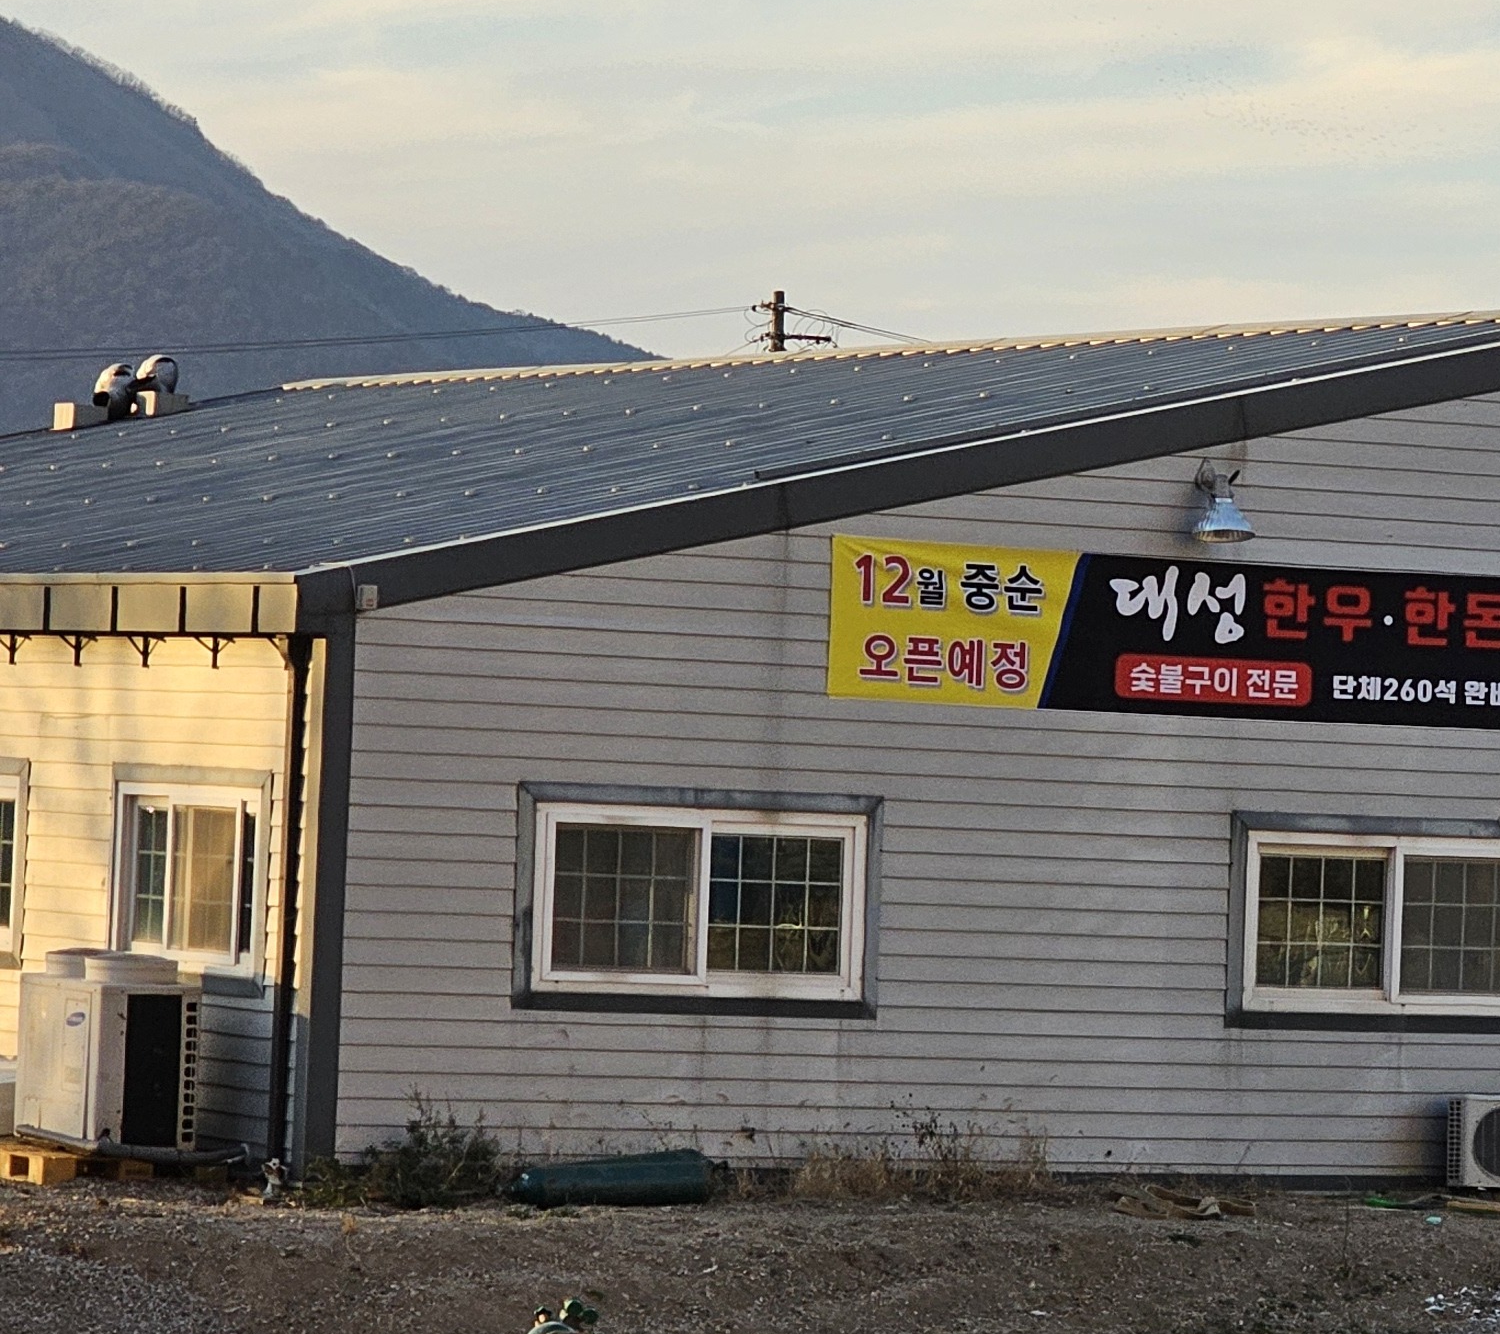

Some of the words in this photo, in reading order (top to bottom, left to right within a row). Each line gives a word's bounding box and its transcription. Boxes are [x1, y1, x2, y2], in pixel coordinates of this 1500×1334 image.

[854, 554, 946, 607] 12월
[959, 562, 1046, 614] 중순
[1110, 565, 1247, 645] 대성
[859, 633, 1029, 691] 오픈예정
[1130, 662, 1238, 696] 숯불구이
[1246, 668, 1299, 700] 전문
[1332, 675, 1457, 705] 단체260석
